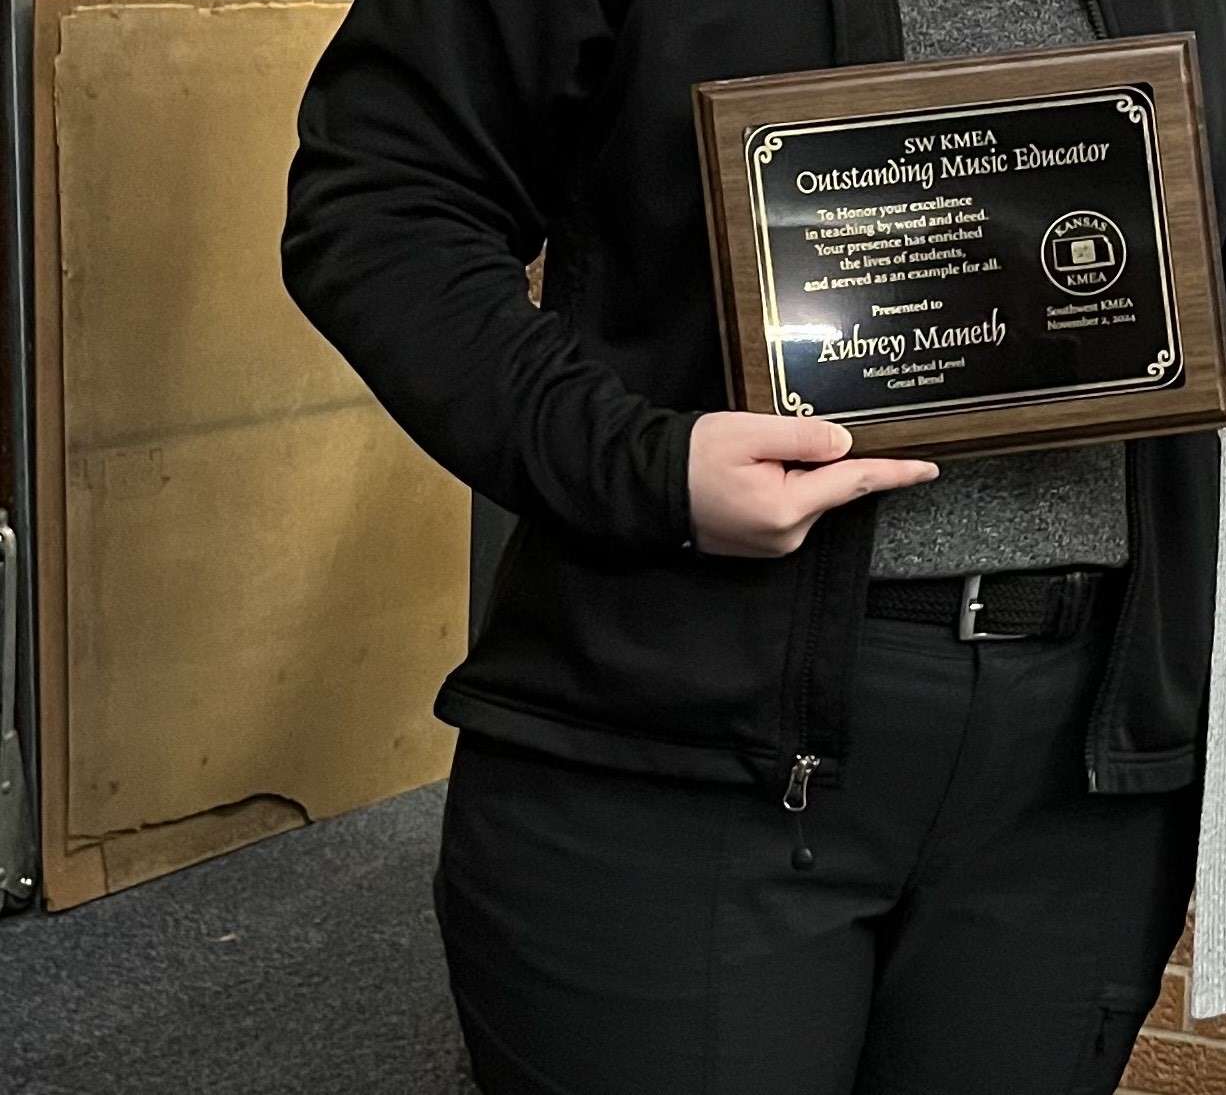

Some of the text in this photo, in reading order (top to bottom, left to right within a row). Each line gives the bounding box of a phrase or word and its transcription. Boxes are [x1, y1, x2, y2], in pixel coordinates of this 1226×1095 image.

[904, 129, 998, 155] SW KMEA
[796, 141, 1110, 195] Outstanding Music Educator
[816, 196, 973, 222] To Honor your excellence
[805, 208, 990, 241] in teaching by word and deed.
[1055, 217, 1108, 237] KANSAS
[814, 225, 983, 256] Your presence has enriched
[840, 248, 967, 271] the lives of students,
[804, 257, 1003, 292] and served as an example for all.
[1066, 271, 1107, 286] KMEA
[871, 299, 943, 317] Presented to
[1100, 297, 1134, 311] KMEA
[817, 307, 1006, 363] Aubrey Maneth
[1047, 316, 1099, 331] November
[863, 355, 966, 379] Middle School Level
[887, 372, 945, 390] Great Bend
